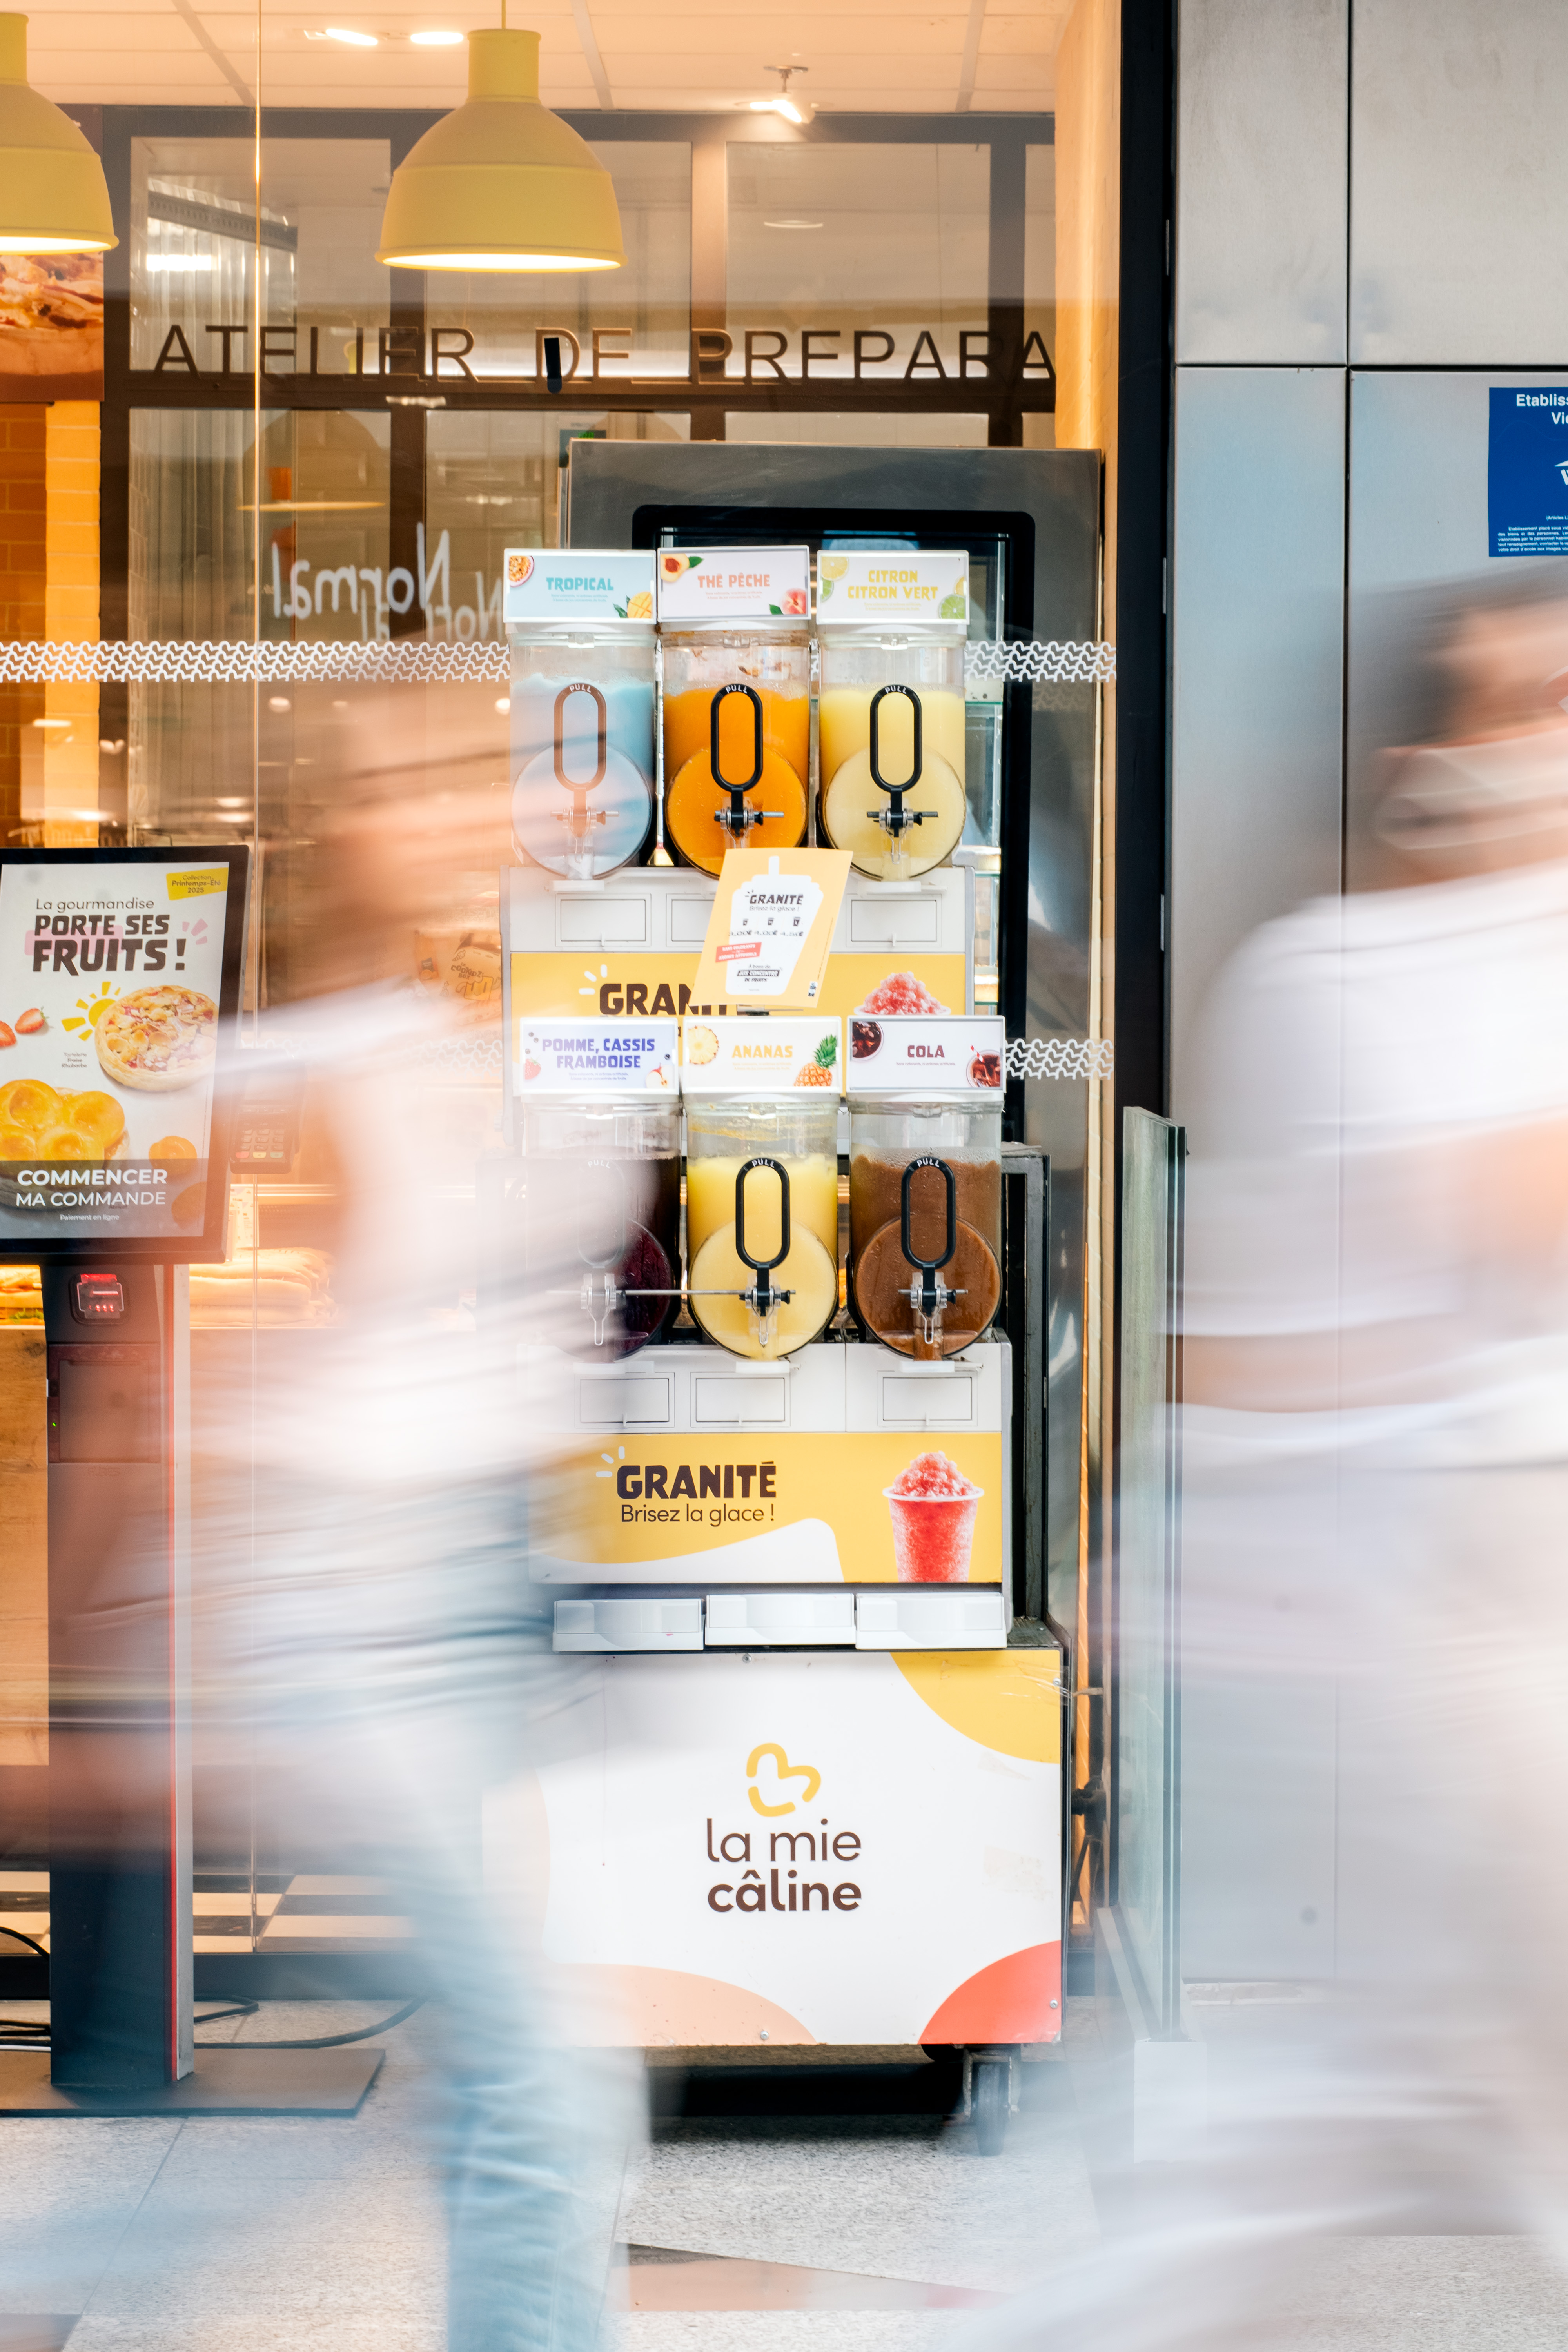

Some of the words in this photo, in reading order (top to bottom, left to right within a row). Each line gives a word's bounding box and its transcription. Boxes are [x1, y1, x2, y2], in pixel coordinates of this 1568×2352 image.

[152, 325, 479, 383] ATELIER
[535, 327, 632, 384] DE
[691, 328, 1056, 385] PREPARA
[1516, 393, 1568, 407] Etablis
[729, 573, 770, 587] PÊCHE
[868, 570, 918, 583] CITRON
[546, 577, 614, 592] TROPICAL
[848, 586, 897, 599] CITRON
[903, 586, 938, 601] VERT
[569, 684, 591, 693] PULL
[726, 684, 747, 693] PULL
[885, 685, 906, 694] PULL
[172, 878, 221, 887] Printemps-Été
[36, 898, 52, 910] La
[57, 897, 154, 913] gourmandise
[34, 915, 116, 936] PORTE
[125, 915, 170, 935] SES
[33, 938, 168, 976] FRUITS
[542, 1038, 599, 1054] POMME,
[603, 1038, 655, 1051] CASSIS
[732, 1045, 793, 1058] ANANAS
[907, 1045, 945, 1058] COLA
[557, 1055, 641, 1069] FRAMBOISE
[588, 1159, 610, 1168] PULL
[751, 1158, 775, 1168] PULL
[916, 1158, 940, 1168] PULL
[17, 1169, 168, 1186] COMMENCER
[16, 1192, 45, 1207] MA
[50, 1191, 166, 1207] COMMANDE
[617, 1461, 777, 1499] GRANITÉ
[621, 1504, 680, 1522] Brisez
[686, 1503, 703, 1522] la
[709, 1503, 764, 1527] glace
[770, 1504, 774, 1521] !
[707, 1818, 751, 1862] la
[770, 1818, 861, 1862] mie
[708, 1868, 862, 1912] câline
